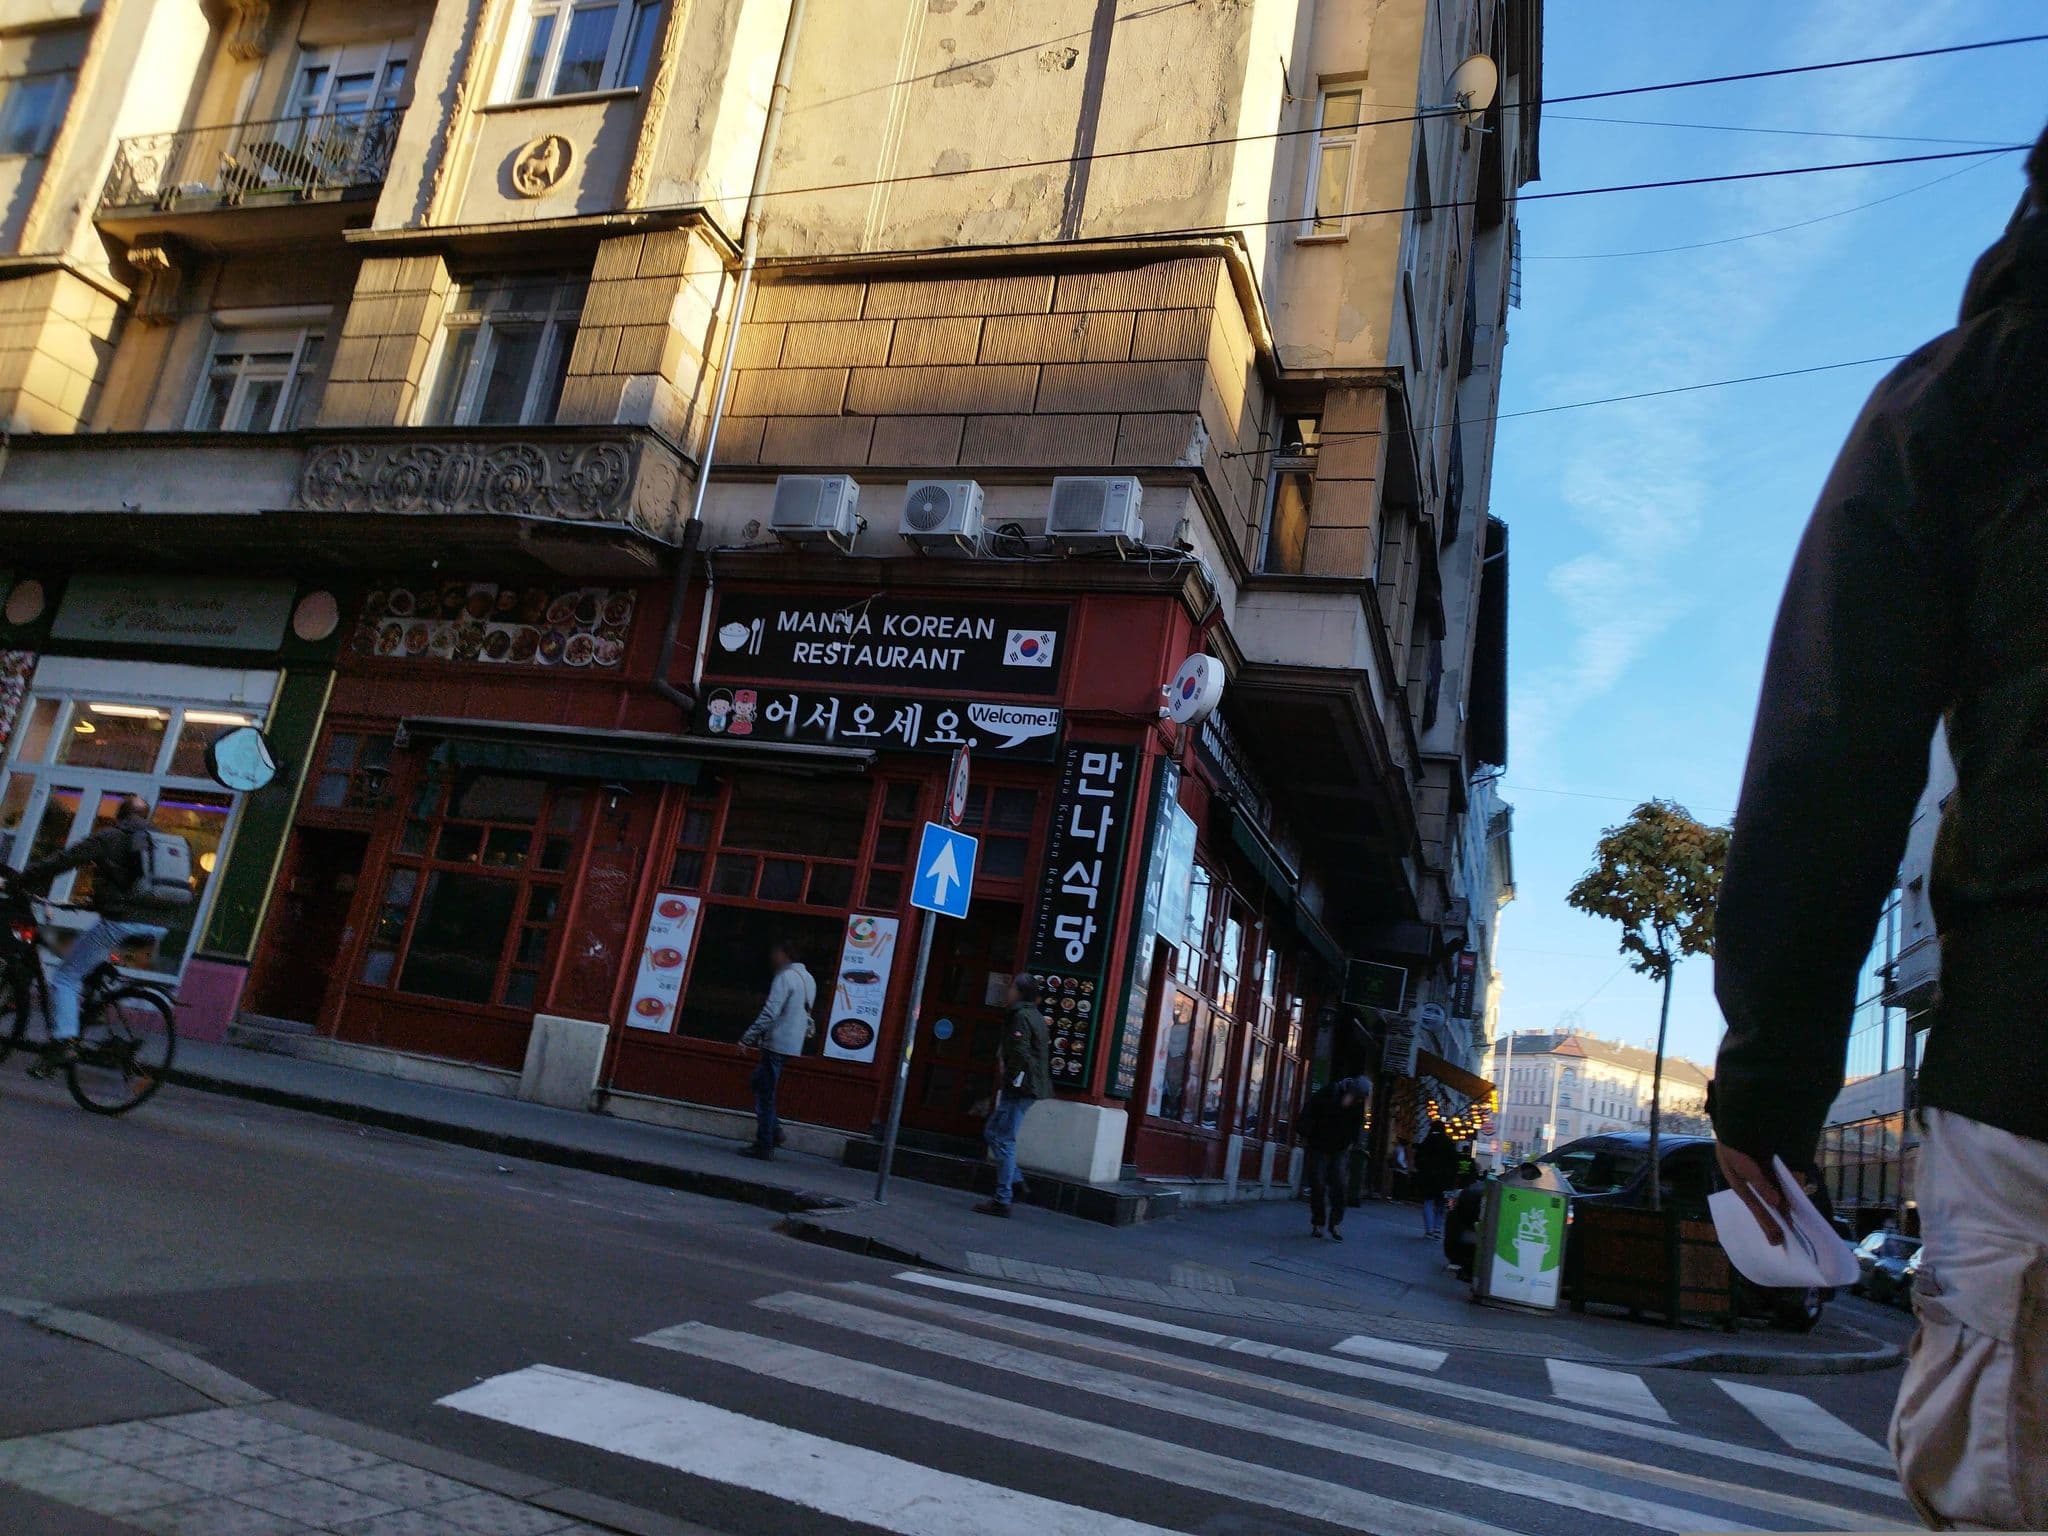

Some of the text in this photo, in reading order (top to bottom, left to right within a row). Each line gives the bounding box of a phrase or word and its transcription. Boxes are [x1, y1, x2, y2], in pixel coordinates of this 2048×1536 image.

[777, 610, 995, 640] MANNA KOREAN
[792, 642, 965, 672] RESTAURANT
[765, 693, 978, 748] 어서오세요.
[971, 706, 1059, 728] Welcome!!
[1033, 748, 1078, 958] Manna Korean Restaurant
[1053, 751, 1124, 964] 만나식당
